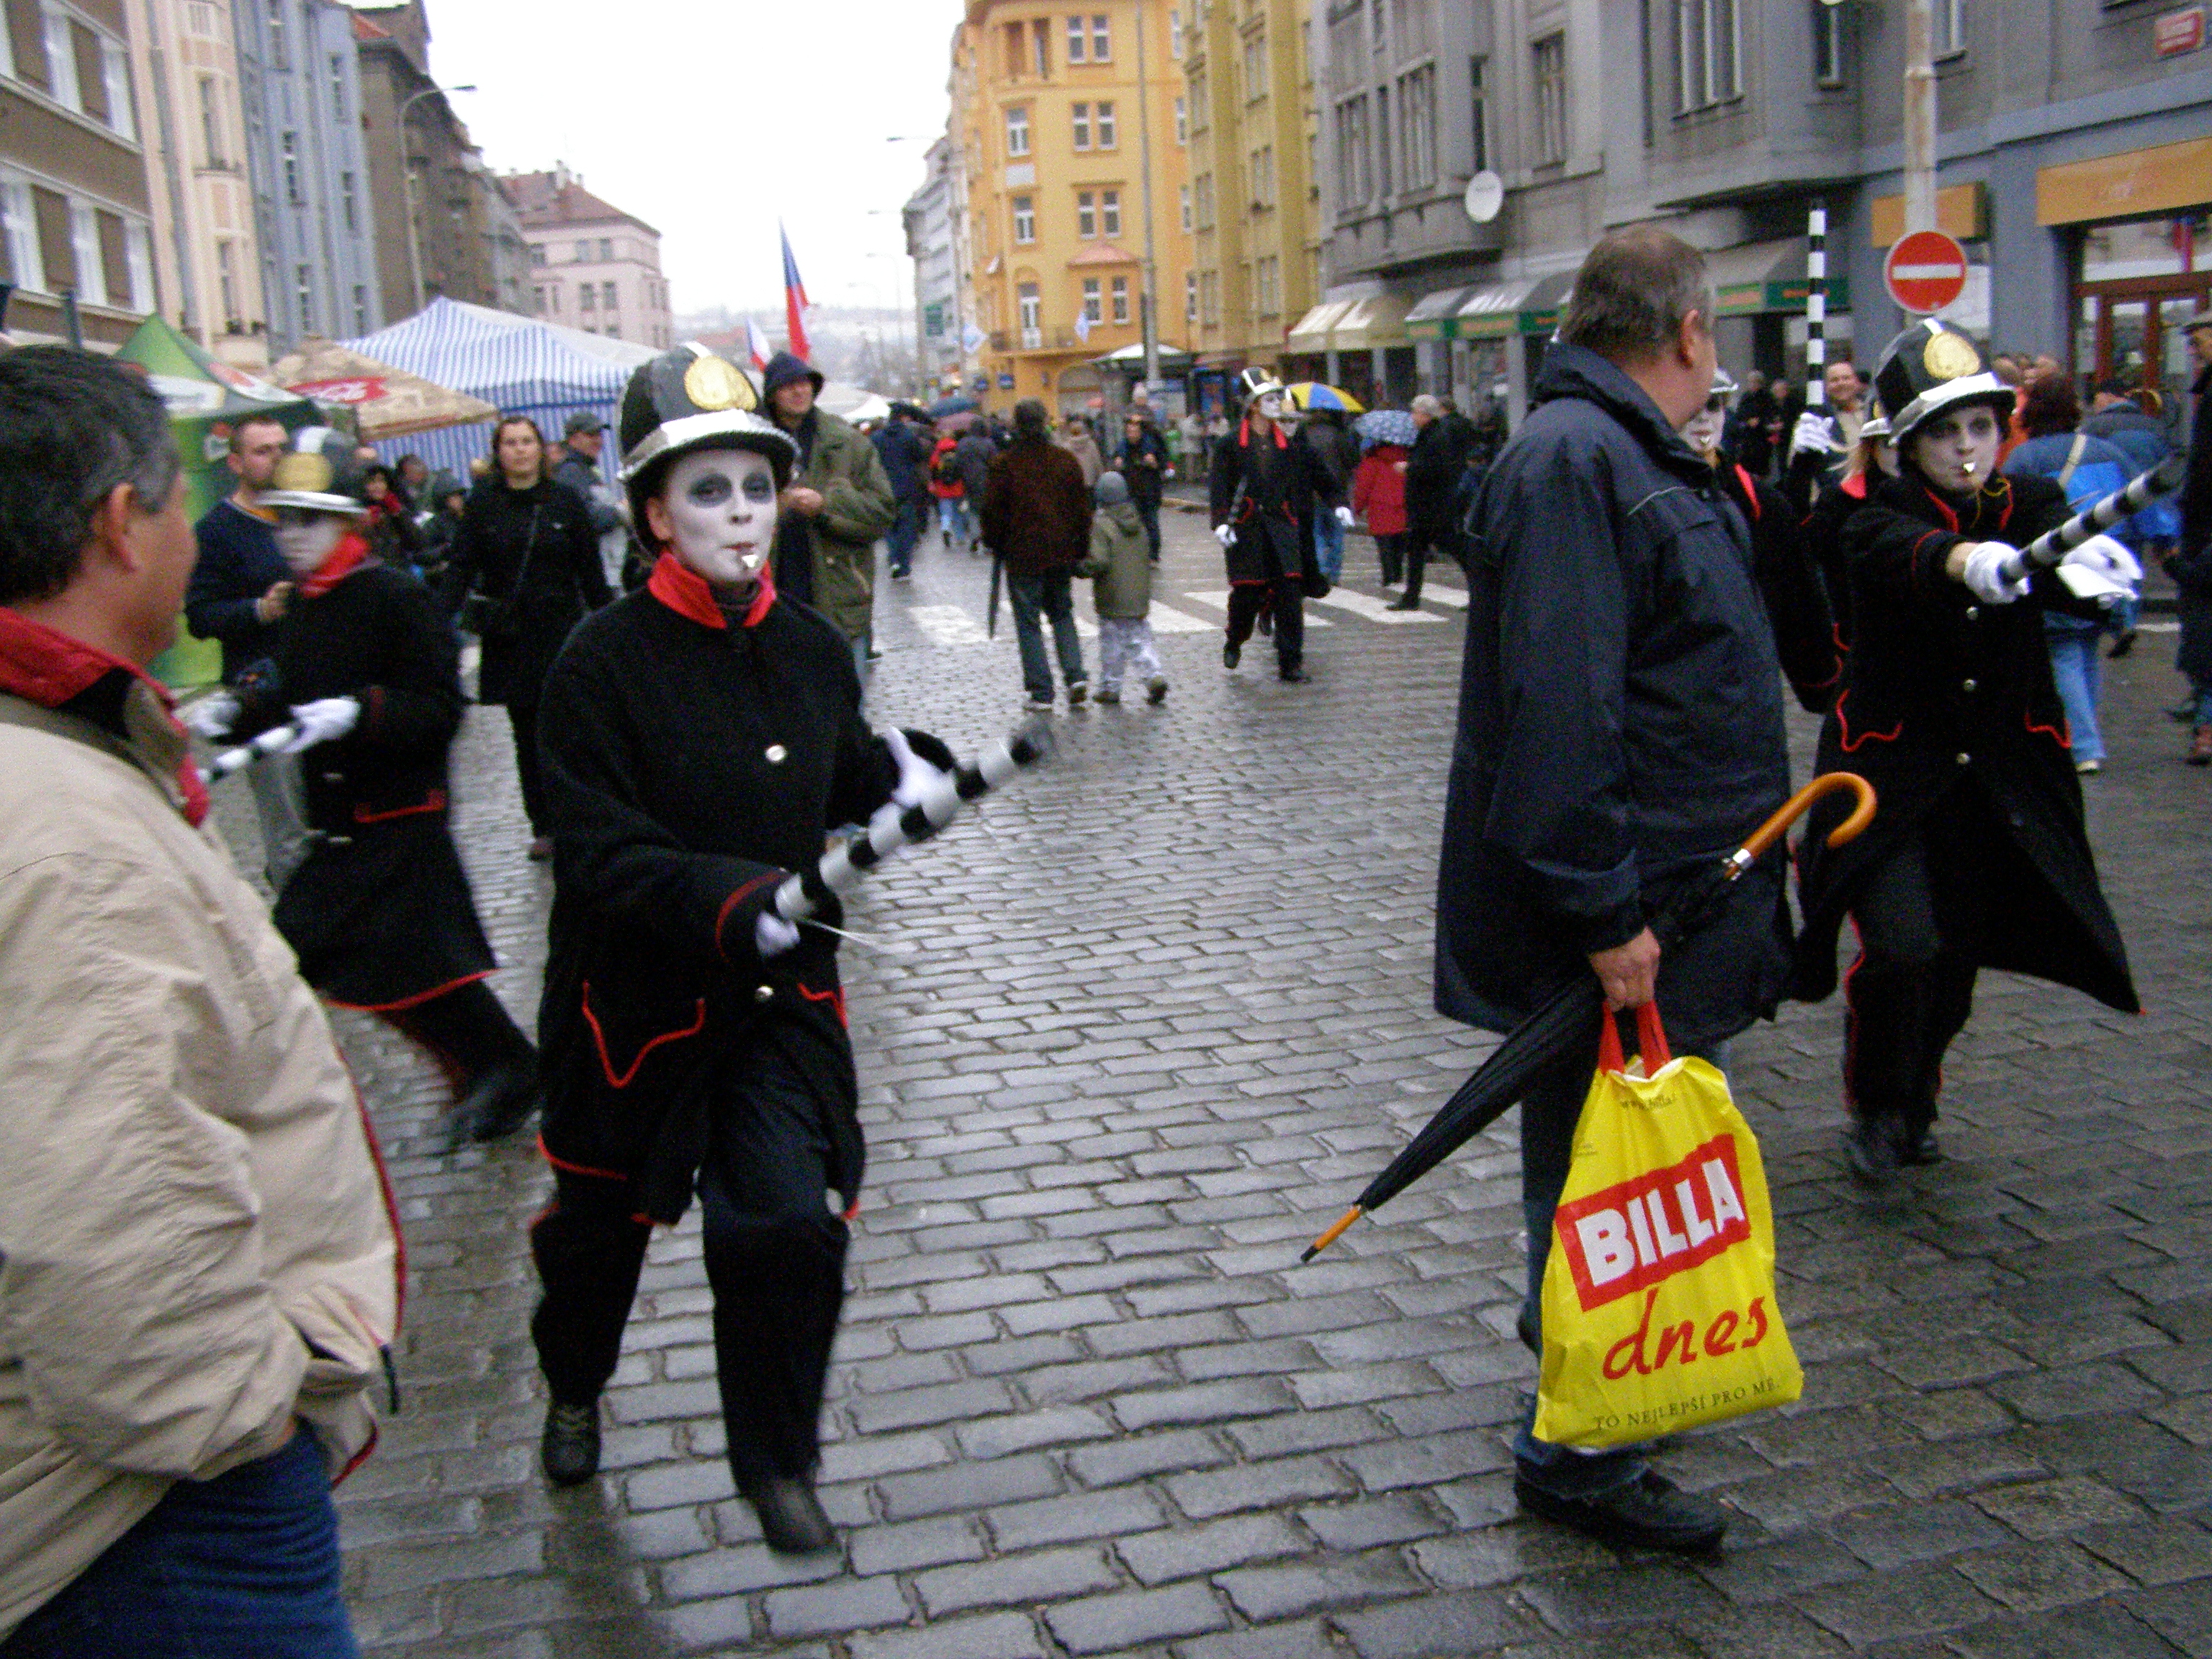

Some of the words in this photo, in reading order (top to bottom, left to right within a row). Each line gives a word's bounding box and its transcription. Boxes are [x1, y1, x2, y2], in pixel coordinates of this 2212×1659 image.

[1575, 1159, 1745, 1287] BILLA
[1604, 1288, 1768, 1379] dnes
[1593, 1414, 1620, 1430] TO
[1712, 1387, 1745, 1406] PRO
